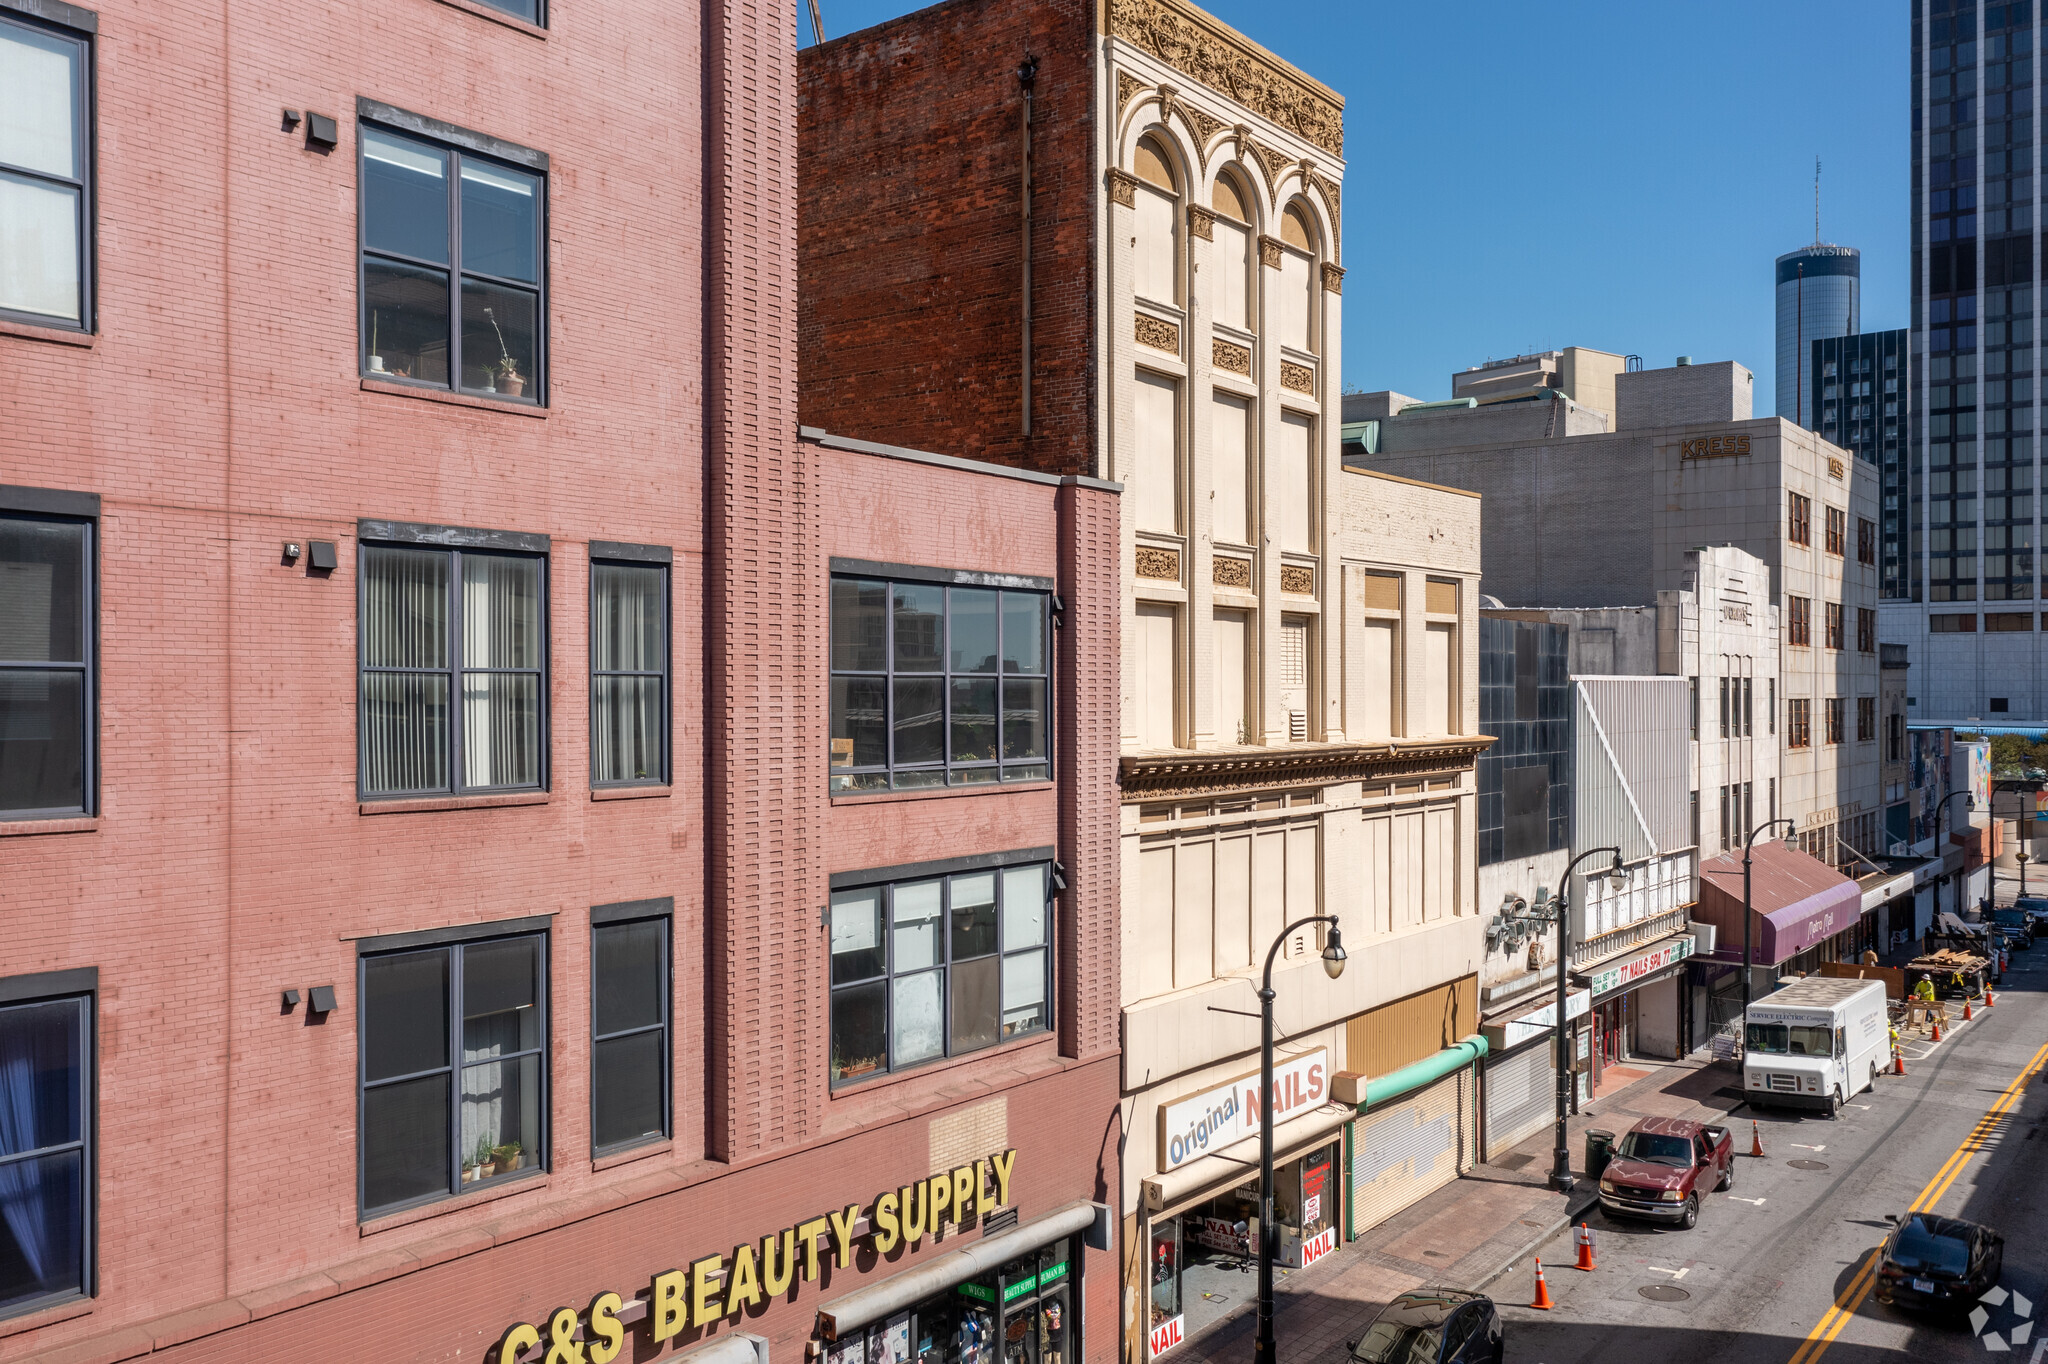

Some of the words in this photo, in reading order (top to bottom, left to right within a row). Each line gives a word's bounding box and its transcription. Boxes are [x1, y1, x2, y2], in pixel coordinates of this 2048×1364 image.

[1808, 247, 1852, 257] WESTIN
[1681, 435, 1751, 457] KRESS
[1807, 919, 1823, 941] Metro
[1823, 911, 1834, 933] Mall
[1620, 966, 1628, 983] 77
[1629, 957, 1648, 980] NAILS
[1649, 952, 1661, 971] SPA
[1662, 949, 1671, 966] 77
[1775, 1013, 1806, 1021] ELECTRIC
[1806, 1014, 1831, 1022] Company
[1170, 1085, 1240, 1165] Original
[1246, 1063, 1324, 1127] NAILS
[499, 1290, 624, 1364] C&S
[652, 1203, 860, 1343] BEAUTY
[872, 1148, 1017, 1254] SUPPLY
[1303, 1231, 1332, 1266] NAIL
[1041, 1267, 1058, 1282] HUMAN
[967, 1284, 986, 1298] WIGS
[1004, 1284, 1020, 1300] BEAUTY
[1020, 1277, 1036, 1293] SUPPLY
[1151, 1320, 1182, 1356] NAIL
[1009, 1344, 1023, 1357] ATM
